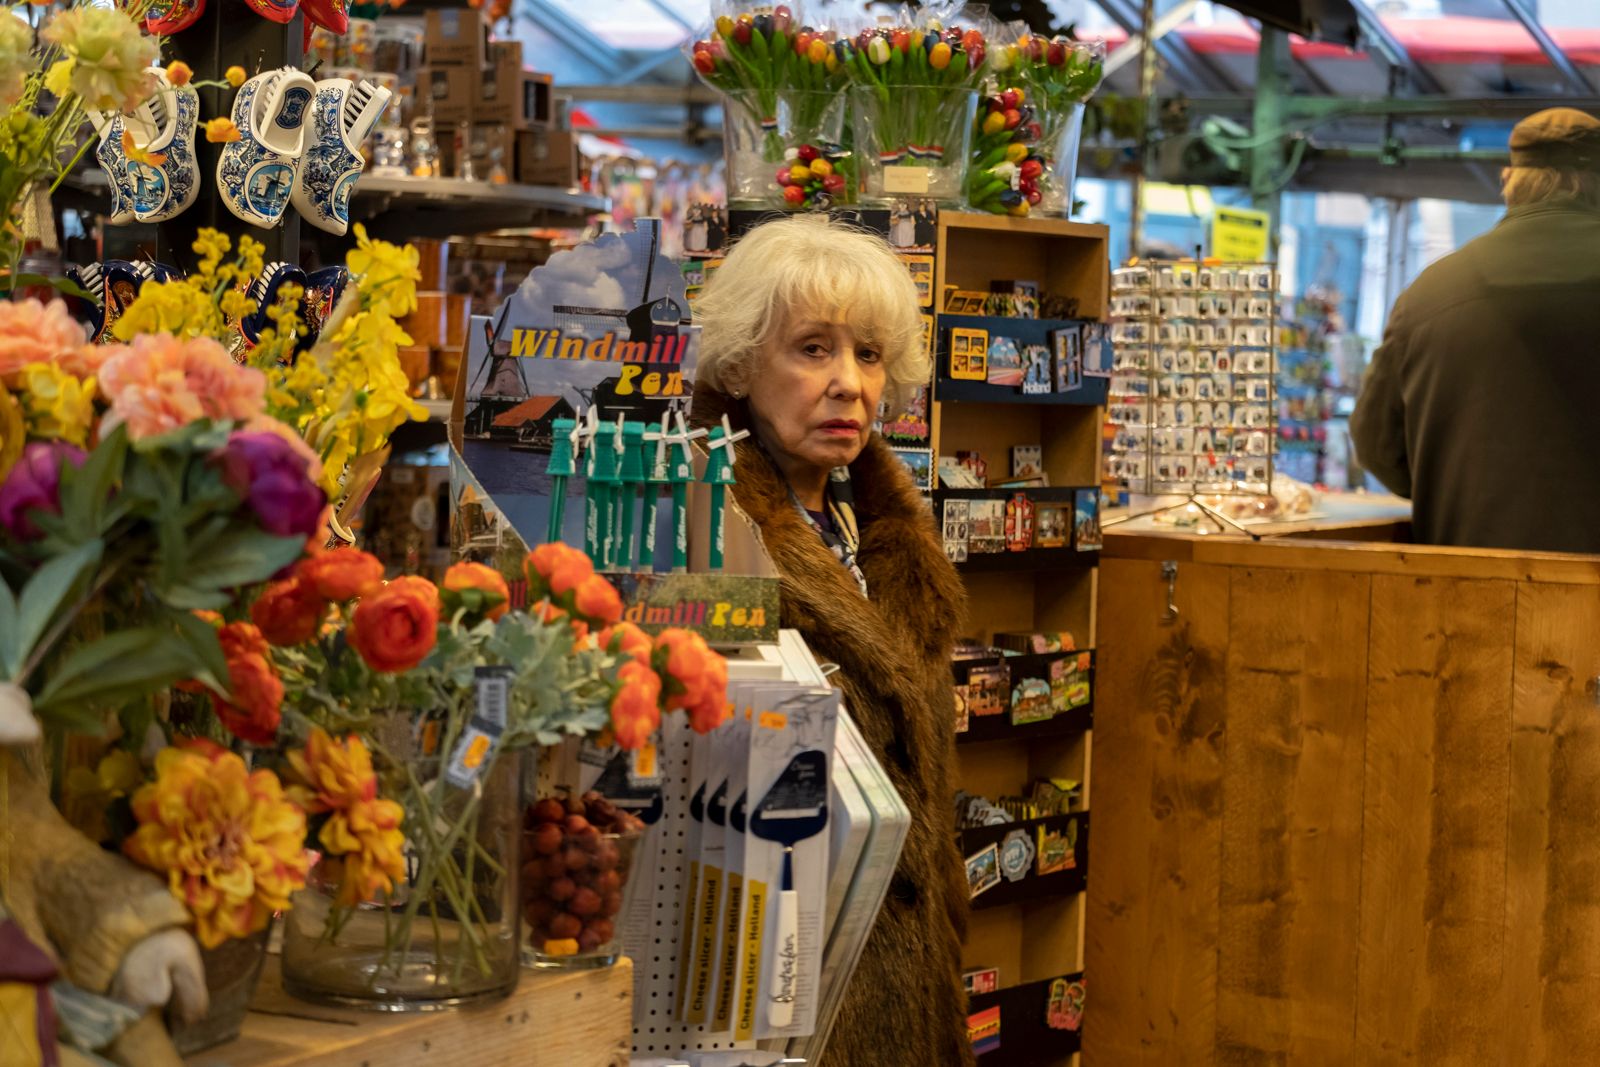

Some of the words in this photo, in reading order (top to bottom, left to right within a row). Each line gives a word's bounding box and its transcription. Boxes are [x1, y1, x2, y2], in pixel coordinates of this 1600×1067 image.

[510, 328, 688, 362] Windmill
[614, 364, 684, 395] Pen
[625, 601, 706, 626] dmill
[711, 602, 766, 627] Pen
[703, 879, 717, 925] Holland
[728, 887, 741, 933] Holland
[749, 894, 761, 941] Holland
[700, 936, 711, 968] slicer
[725, 945, 736, 976] slicer
[746, 953, 758, 985] slicer
[693, 971, 708, 1011] Cheese
[717, 980, 732, 1020] Cheese
[740, 988, 754, 1030] Cheese
